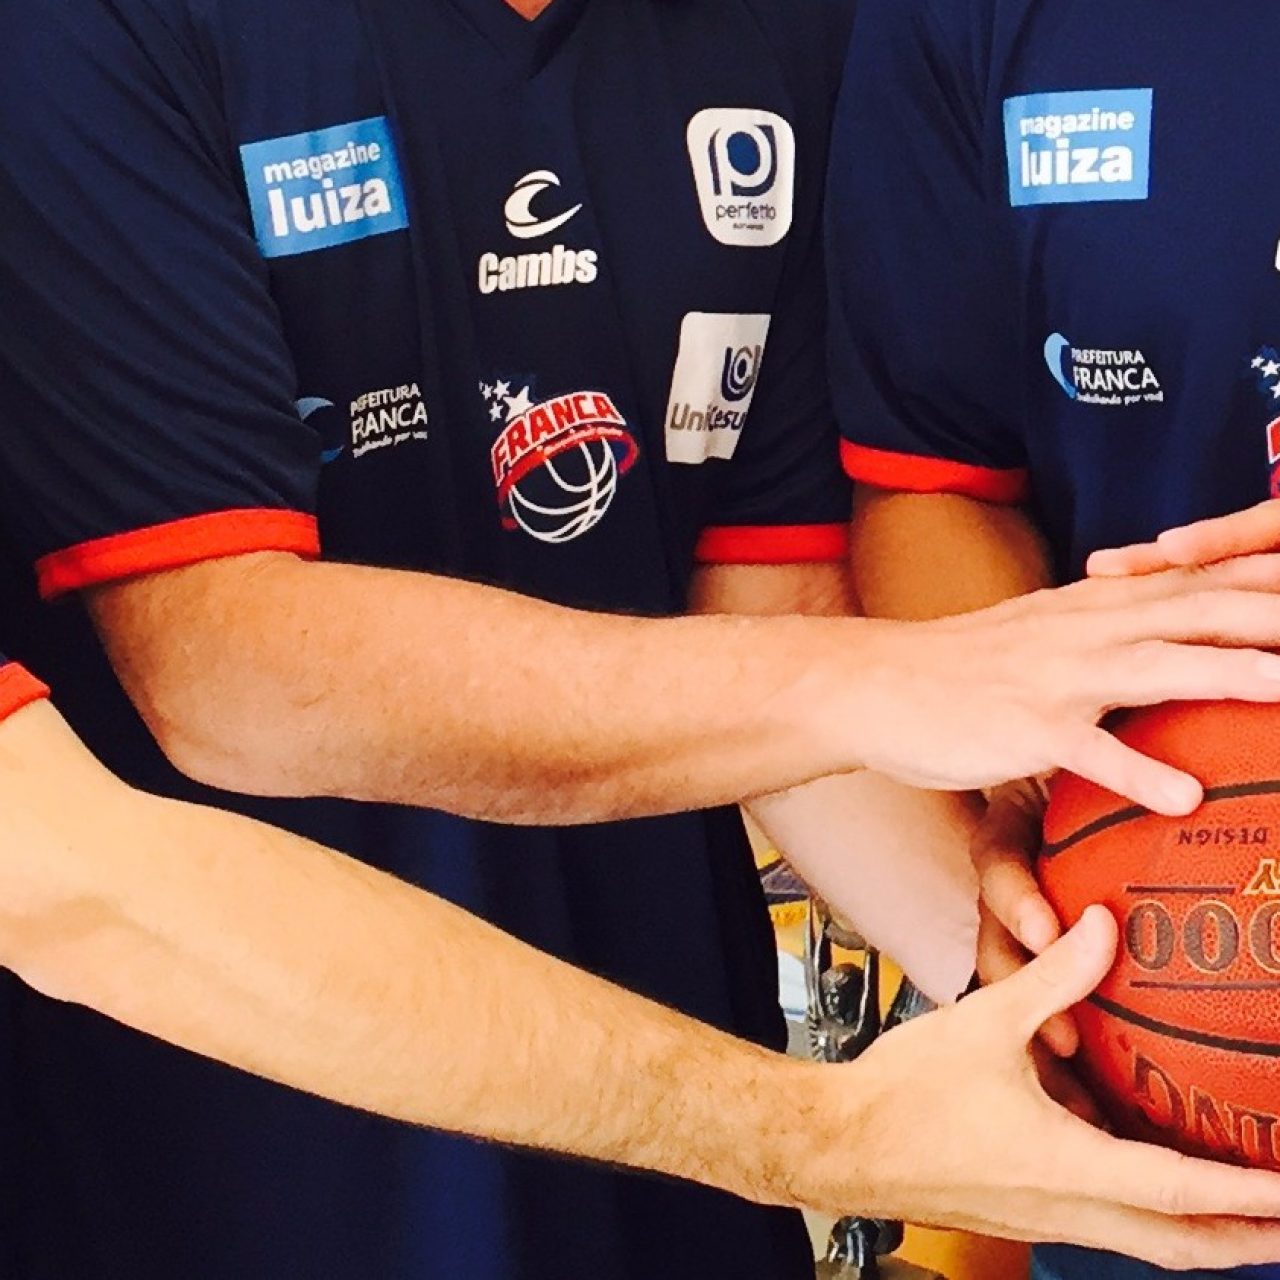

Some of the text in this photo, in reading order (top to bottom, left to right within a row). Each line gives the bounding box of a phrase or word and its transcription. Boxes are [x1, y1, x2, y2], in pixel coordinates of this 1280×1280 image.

[1020, 107, 1134, 138] magazine
[263, 141, 381, 184] magazine
[1021, 138, 1133, 187] luiza
[267, 177, 391, 237] luiza
[478, 244, 598, 294] Cambs
[1073, 366, 1161, 391] FRANCA
[490, 391, 627, 487] FRANCA
[1178, 826, 1268, 845] DESIGN
